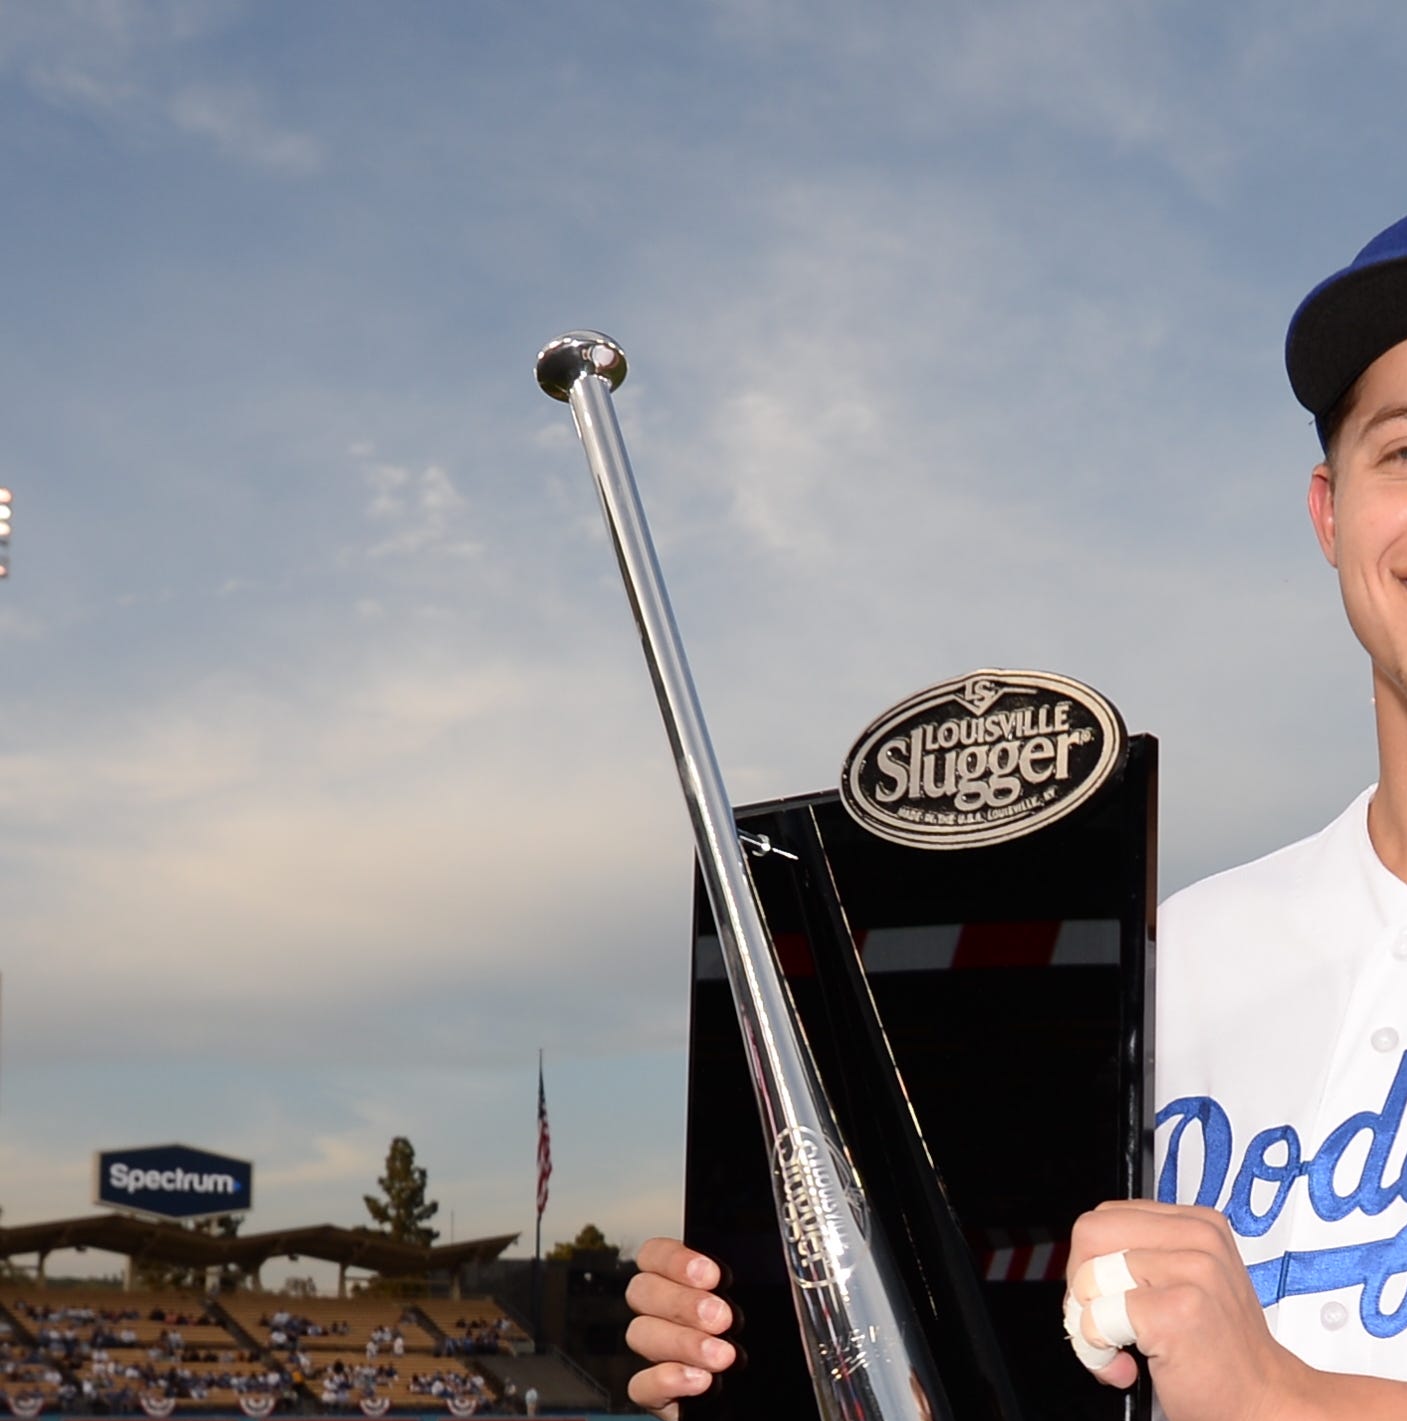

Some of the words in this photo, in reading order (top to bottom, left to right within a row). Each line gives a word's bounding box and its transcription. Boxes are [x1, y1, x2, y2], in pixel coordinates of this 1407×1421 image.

[922, 700, 1074, 751] LOUISVILLE
[874, 727, 1082, 812] Slugger
[109, 1162, 235, 1195] Spectrum
